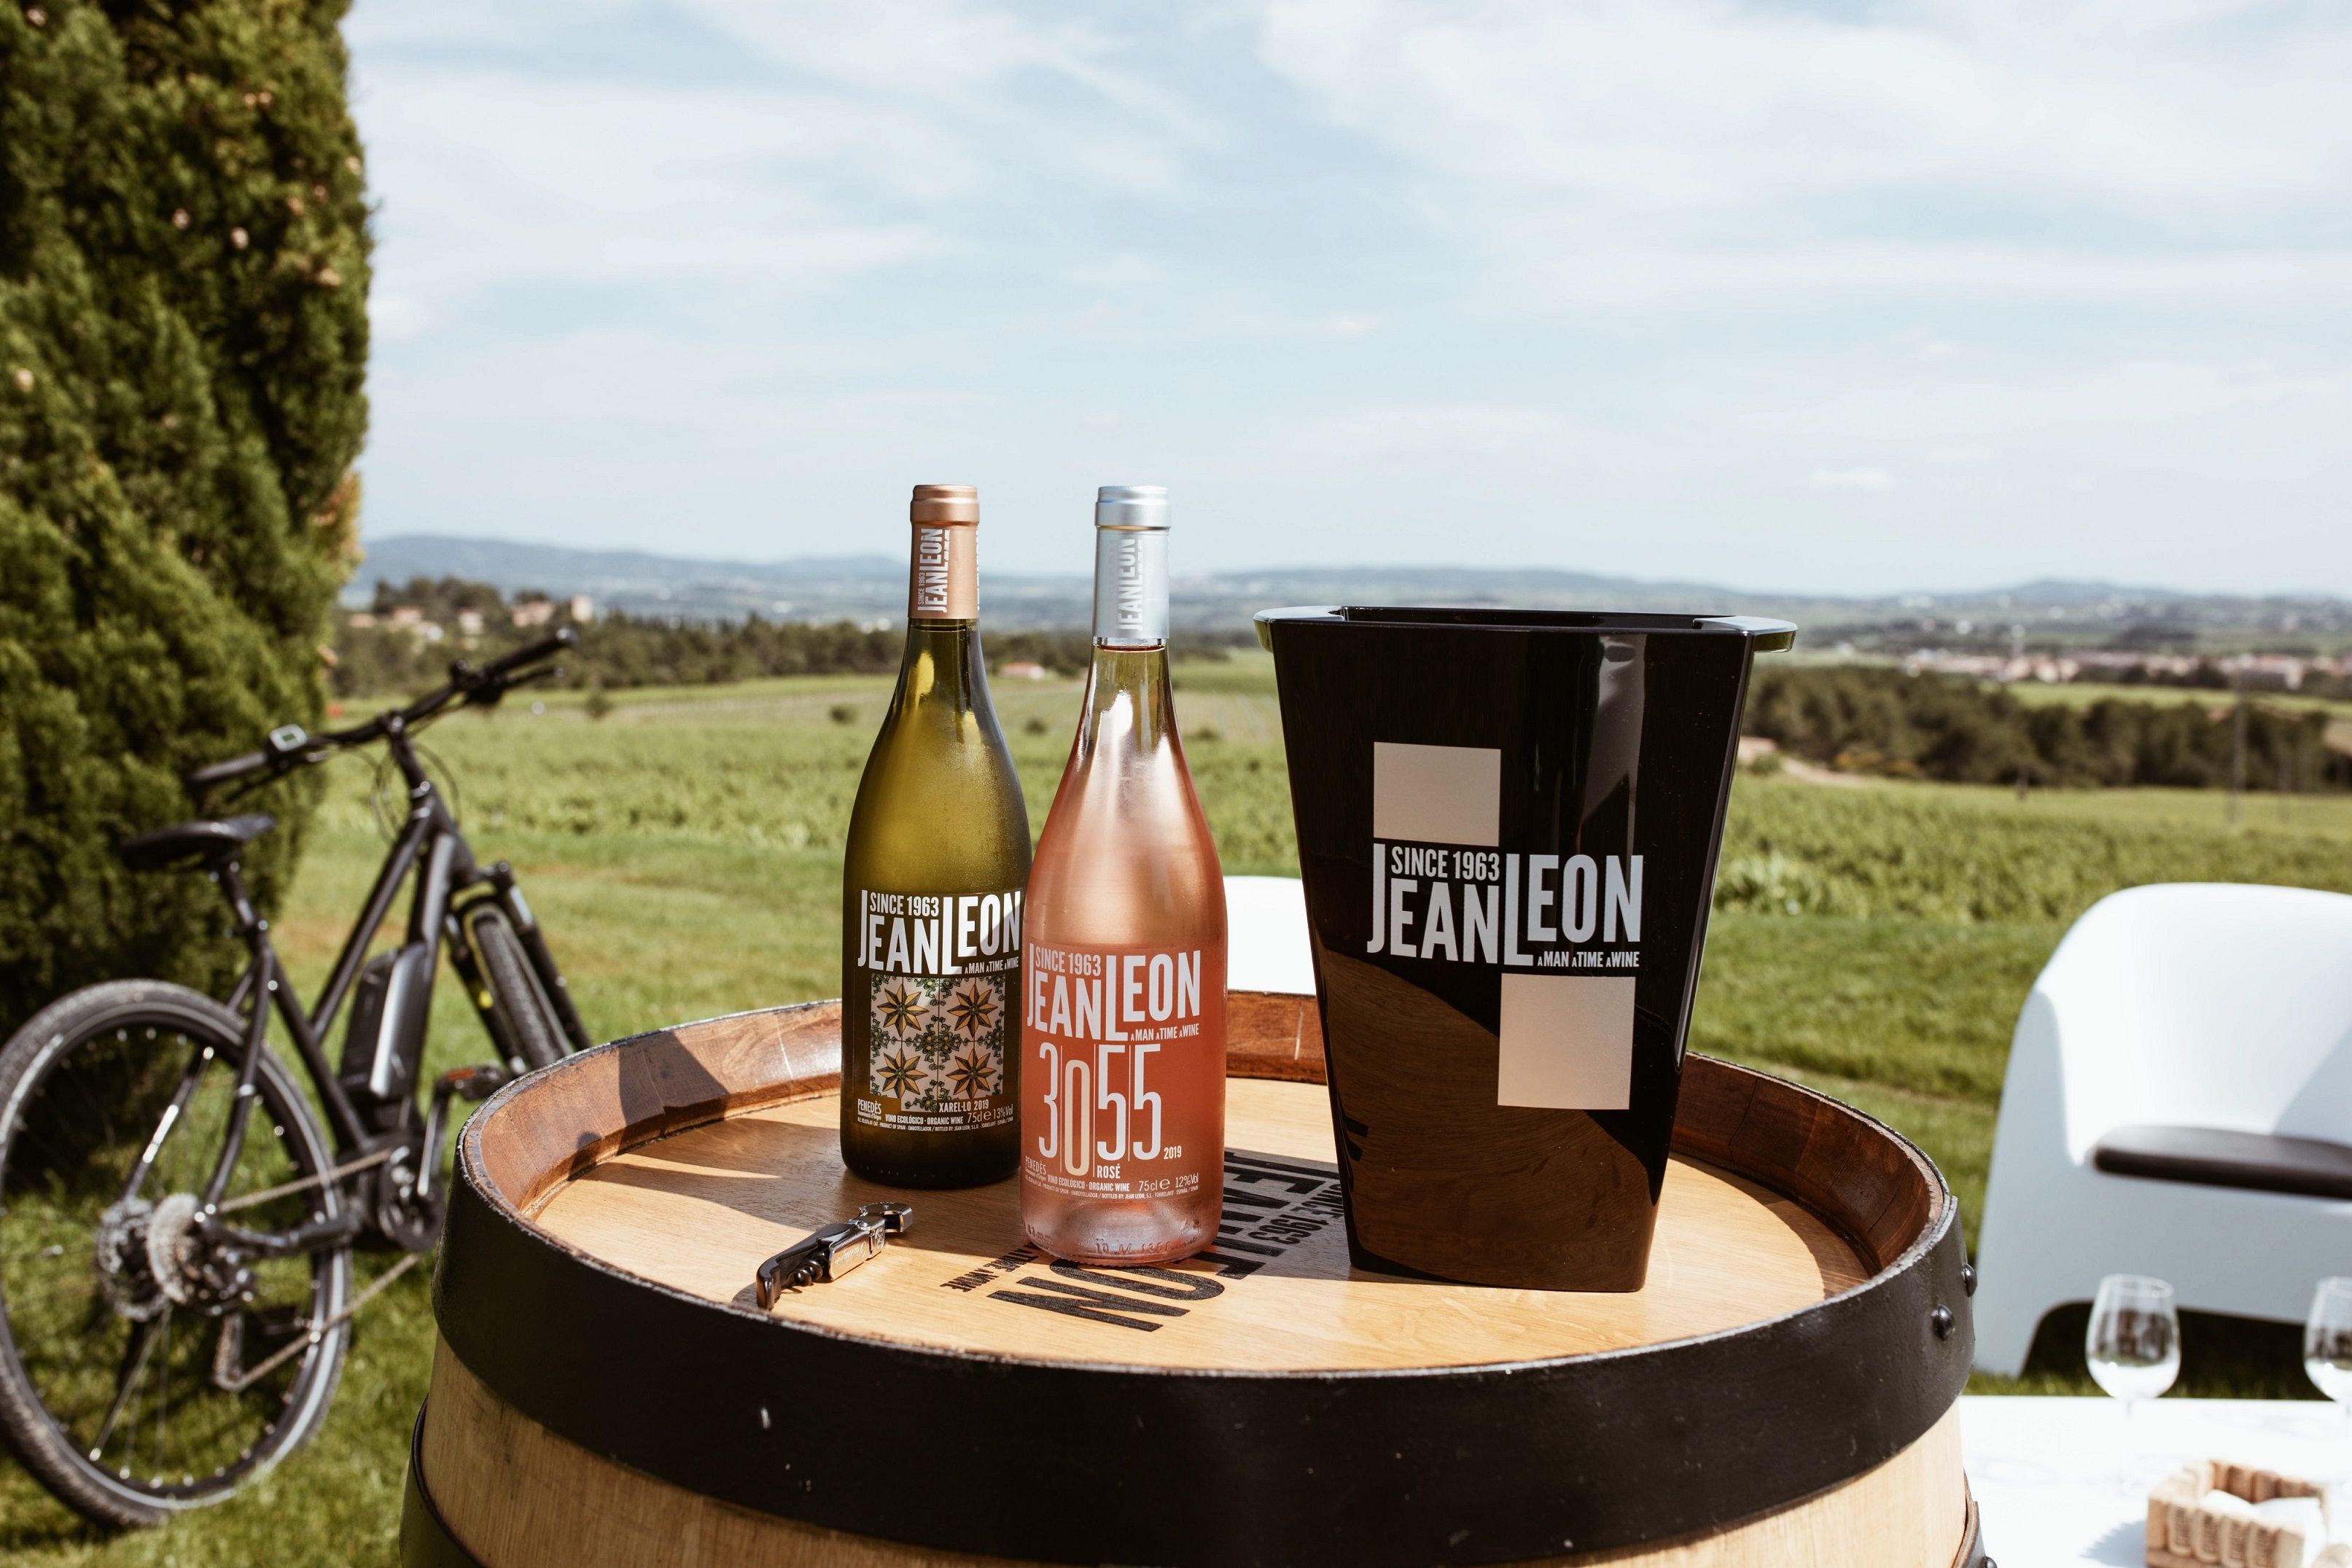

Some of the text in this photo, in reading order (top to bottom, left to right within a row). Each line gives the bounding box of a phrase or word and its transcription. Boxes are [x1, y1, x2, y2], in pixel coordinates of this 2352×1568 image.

[1390, 846, 1500, 881] SINCE 1963
[870, 892, 939, 917] SINCE 1963
[1035, 945, 1102, 977] SINCE 1963
[857, 1098, 881, 1115] PENEDÈS
[974, 1099, 989, 1111] 2019
[1038, 1042, 1162, 1177] 3055
[885, 1113, 897, 1123] VINO
[927, 1116, 950, 1126] ORGANIC
[950, 1116, 964, 1125] WINE
[1164, 1145, 1182, 1160] 2019
[1025, 1155, 1046, 1175] PENEDÈS
[1097, 1163, 1121, 1179] ROSÉ
[1047, 1174, 1058, 1185] VINO
[1059, 1177, 1085, 1189] ECOLÓGICO
[1089, 1182, 1113, 1191] ORGANIC
[1115, 1183, 1130, 1192] WINE
[1139, 1179, 1158, 1192] 75cl
[1248, 1214, 1330, 1245] 1963
